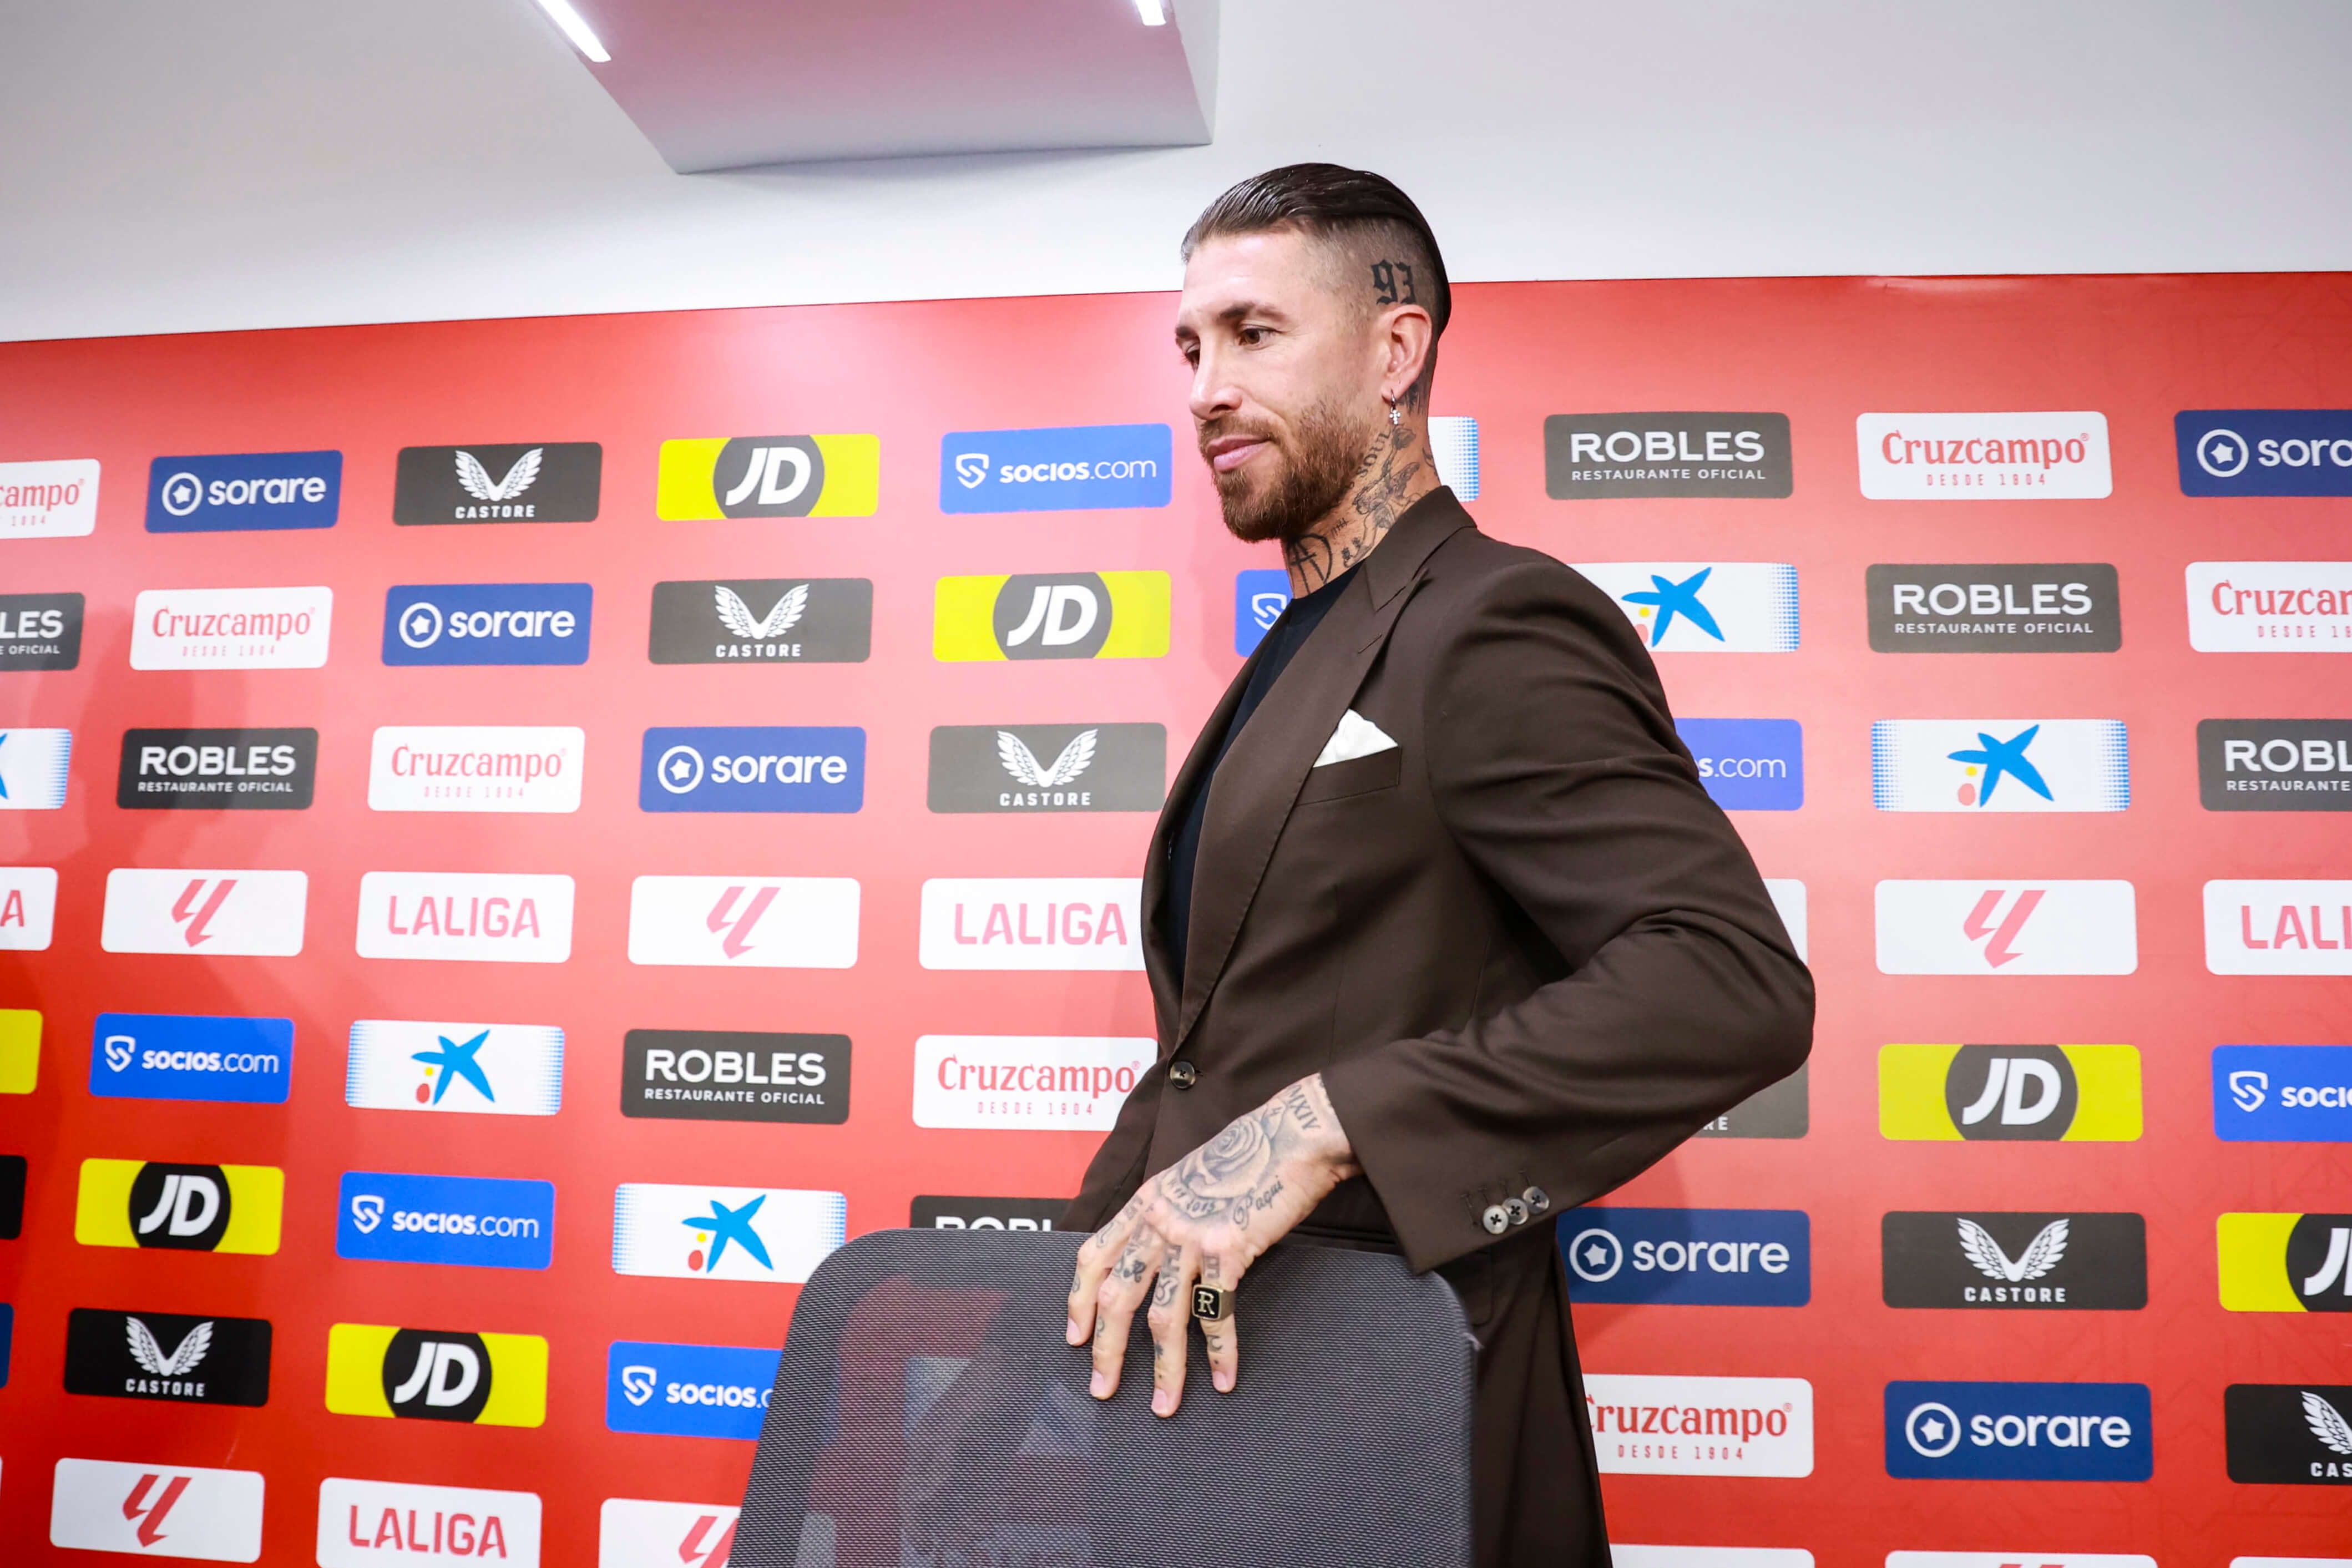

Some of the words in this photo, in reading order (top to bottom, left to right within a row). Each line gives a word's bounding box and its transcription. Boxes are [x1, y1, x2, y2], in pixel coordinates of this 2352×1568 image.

[1571, 431, 1764, 463] ROBLES
[1882, 430, 2086, 470] Cruzcampo
[725, 446, 812, 506] JD
[1572, 469, 1691, 480] RESTAURANTE
[1697, 469, 1766, 479] OFICIAL
[1926, 473, 1984, 487] DESDE
[208, 477, 326, 505] sorare
[455, 504, 535, 519] CASTORE
[1893, 583, 2092, 616] ROBLES
[152, 608, 310, 641] Cruzcampo
[448, 610, 575, 638] sorare
[1006, 584, 1099, 647] JD
[1895, 623, 2017, 634] RESTAURANTE
[2024, 623, 2093, 634] OFICIAL
[2257, 625, 2316, 638] DESDE
[8, 644, 60, 655] OFICIAL
[182, 645, 227, 657] DESDE
[716, 644, 801, 657] CASTORE
[140, 745, 296, 776] ROBLES
[391, 745, 562, 783] Cruzcampo
[711, 755, 847, 784] sorare
[2224, 739, 2352, 773] ROBL
[138, 781, 234, 792] RESTAURANTE
[237, 782, 294, 792] OFICIAL
[423, 785, 472, 798] DESDE
[999, 792, 1091, 806] CASTORE
[2226, 780, 2351, 791] RESTAURANTE
[388, 895, 540, 938] LALIGA
[954, 902, 1128, 945] LALIGA
[645, 1049, 826, 1086] ROBLES
[644, 1088, 755, 1102] RESTAURANTE
[761, 1091, 825, 1105] OFICIAL
[1962, 1058, 2062, 1125] JD
[978, 1101, 1033, 1115] DESDE
[139, 1174, 221, 1238] JD
[1632, 1241, 1790, 1273] sorare
[2303, 1227, 2352, 1296] J
[1197, 1290, 1216, 1315] R
[1964, 1287, 2066, 1302] CASTORE
[125, 1378, 206, 1398] CASTORE
[393, 1341, 480, 1407] JD
[1586, 1393, 1788, 1443] ruzcampo
[1970, 1414, 2131, 1448] sorare
[1617, 1444, 1678, 1459] DESDE
[349, 1505, 507, 1559] LALIGA
